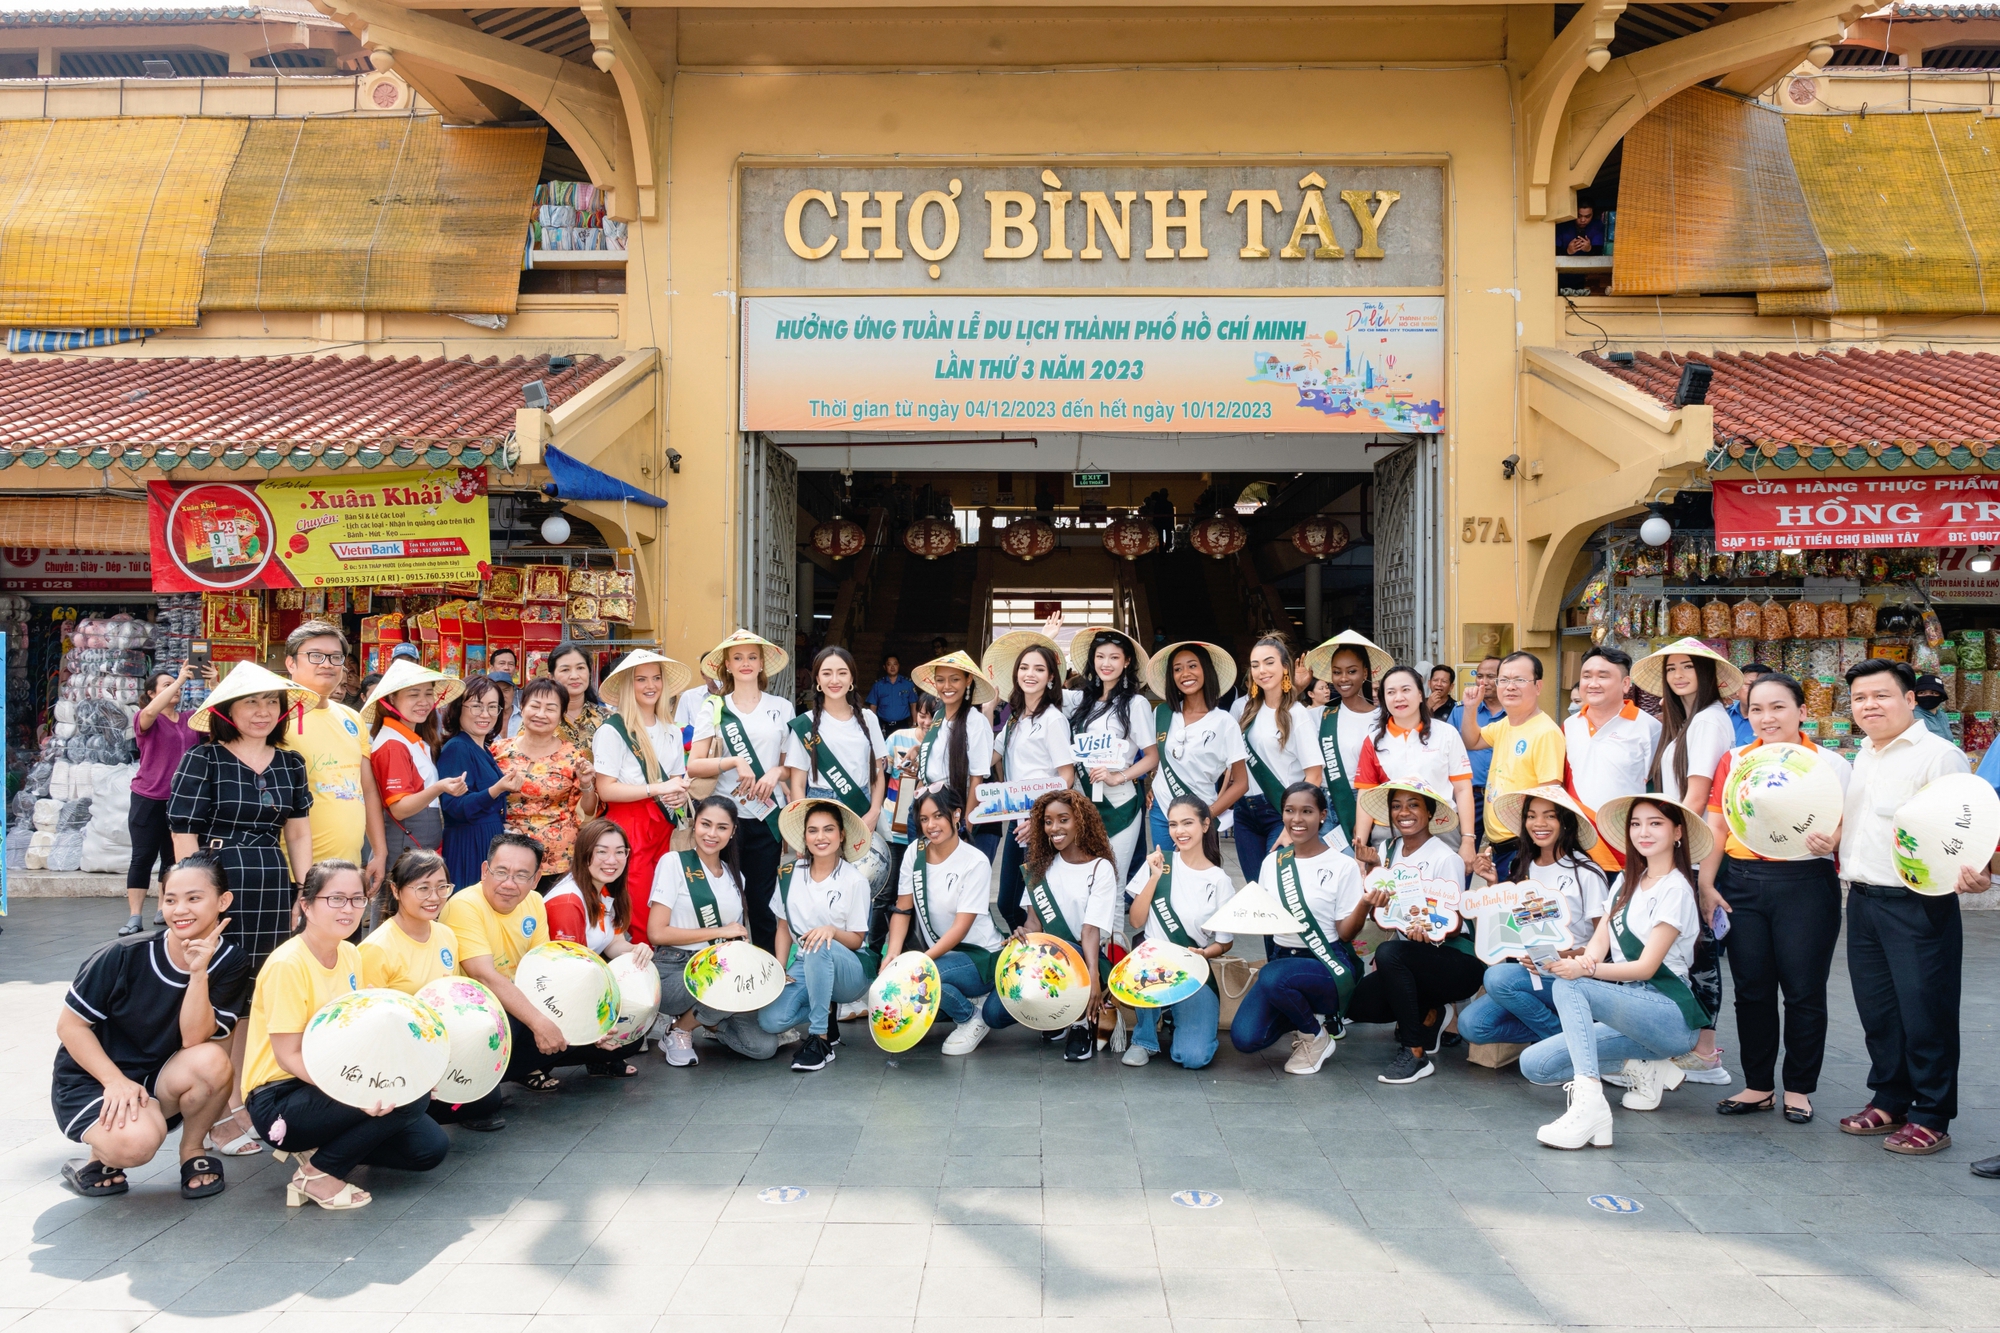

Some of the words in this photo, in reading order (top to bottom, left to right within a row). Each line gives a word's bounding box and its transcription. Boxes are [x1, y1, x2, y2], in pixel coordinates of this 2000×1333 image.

[784, 178, 962, 280] CHỢ
[984, 169, 1208, 260] BÌNH
[1227, 171, 1400, 259] TÂY
[775, 312, 848, 341] HƯỞNG
[853, 314, 897, 340] ỨNG
[902, 310, 956, 340] TUẦN
[957, 310, 982, 340] LỄ
[985, 319, 1013, 340] DU
[1015, 319, 1060, 346] LỊCH
[1064, 315, 1131, 340] THÀNH
[1134, 311, 1178, 340] PHỐ
[1181, 311, 1212, 340] HỒ
[1216, 315, 1250, 340] CHÍ
[1252, 321, 1307, 340] MINH
[1345, 309, 1367, 331] Du
[934, 349, 975, 380] LẦN
[978, 353, 1020, 380] THỨ
[1021, 360, 1035, 380] 3
[1039, 354, 1085, 380] NĂM
[1089, 360, 1145, 380] 2023
[809, 399, 847, 418] Thời
[852, 400, 890, 422] gian
[895, 400, 914, 417] từ
[918, 399, 960, 422] ngày
[965, 400, 1056, 418] 04/12/2023
[1062, 397, 1094, 418] đến
[1100, 398, 1128, 418] hết
[1133, 400, 1175, 423] ngày
[1181, 401, 1273, 419] 10/12/2023
[1741, 481, 1788, 495] CỬA
[1796, 480, 1858, 494] HÀNG
[1864, 480, 1927, 493] THỰC
[1934, 475, 1999, 490] PHẨM
[308, 489, 376, 510] Xuân
[382, 484, 443, 507] Khải
[392, 512, 405, 520] Loại
[1776, 495, 1923, 527] HỒNG
[220, 521, 235, 534] 23
[296, 513, 339, 531] Chuyên:
[346, 522, 359, 530] Lịch
[372, 521, 384, 530] loại
[389, 520, 406, 529] Nhận
[414, 519, 435, 529] quảng
[463, 517, 475, 526] lịch
[1462, 516, 1512, 543] 57A
[213, 533, 221, 545] 9
[347, 530, 364, 539] Bánh
[386, 530, 399, 538] Kẹo
[1721, 537, 1746, 549] SẠP
[1774, 535, 1801, 548] MẶT
[1804, 532, 1832, 546] TIỀN
[1835, 533, 1860, 546] CHỢ
[1863, 532, 1894, 544] BÌNH
[1897, 531, 1920, 543] TÂY
[1948, 532, 1967, 542] ĐT:
[1970, 531, 2000, 541] 0907
[338, 543, 401, 556] VietinBank
[45, 561, 74, 573] Chuyên
[80, 560, 98, 573] Giày
[105, 561, 121, 573] Dép
[129, 561, 140, 572] Túi
[6, 581, 27, 589] ĐT
[42, 581, 73, 589] 028
[325, 575, 375, 584] 0903.935.374
[405, 572, 455, 581] 0915.760.539
[1948, 578, 1962, 588] BÁN
[1970, 579, 1975, 587] &
[1078, 733, 1112, 752] Visit
[1322, 735, 1341, 782] ZAMBIA
[826, 765, 852, 795] LAOS
[981, 788, 989, 797] Du
[989, 787, 1001, 797] lịch
[1009, 785, 1019, 794] Tp.
[1045, 782, 1063, 790] Minh
[1792, 813, 1816, 834] Nam
[1954, 804, 1972, 829] Nam
[1033, 884, 1056, 924] KENYA
[1465, 899, 1481, 911] Chợ
[1482, 892, 1502, 907] Bình
[1502, 889, 1519, 905] Tây
[1154, 897, 1179, 933] INDIA
[1280, 864, 1306, 922] TRINIDAD
[1304, 930, 1345, 976] TOBAGO
[733, 973, 755, 994] Việt
[543, 995, 563, 1018] Nam
